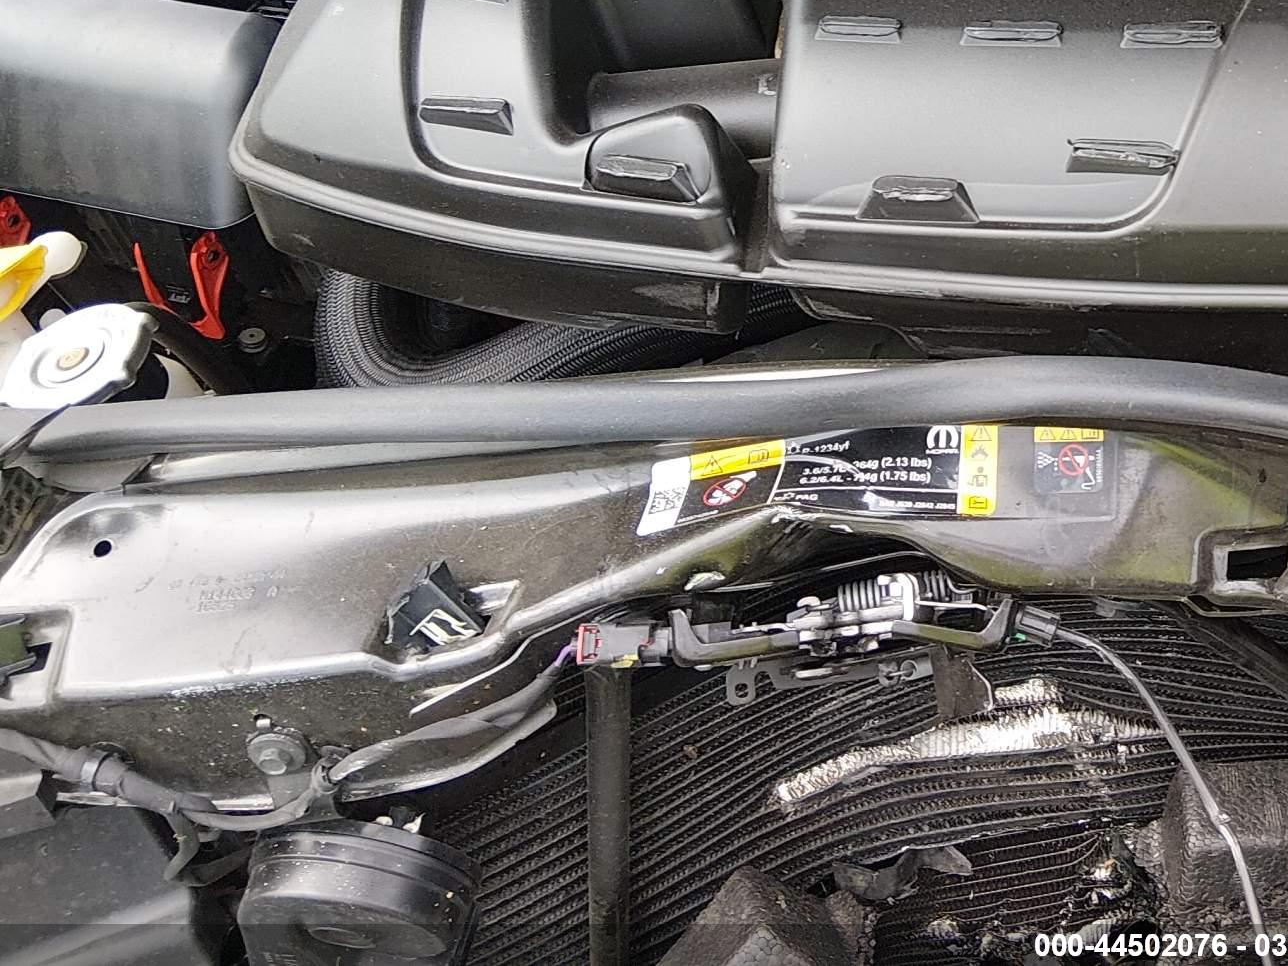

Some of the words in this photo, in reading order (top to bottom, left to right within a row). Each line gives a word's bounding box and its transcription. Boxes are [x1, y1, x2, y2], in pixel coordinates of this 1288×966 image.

[881, 457, 908, 469] (2.13
[911, 457, 932, 469] lbs)
[880, 471, 907, 483] (1.75
[910, 471, 931, 484] lbs)
